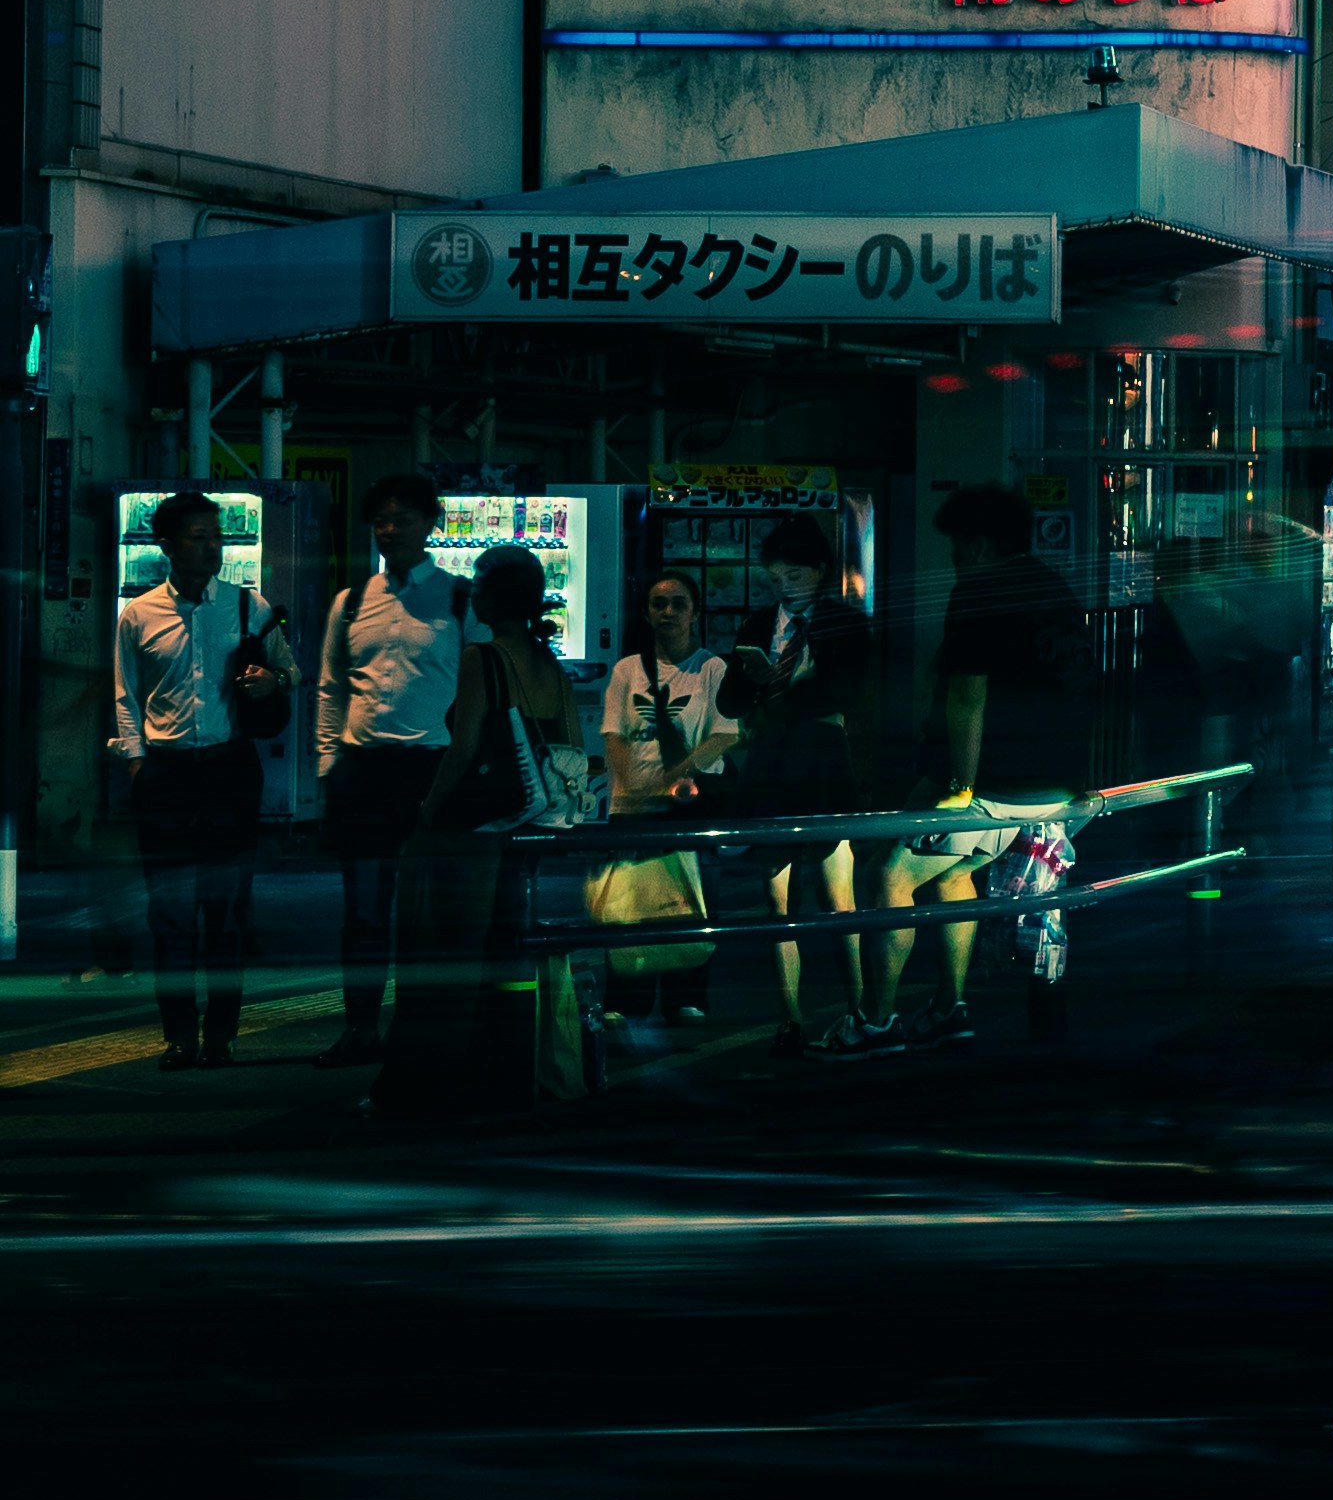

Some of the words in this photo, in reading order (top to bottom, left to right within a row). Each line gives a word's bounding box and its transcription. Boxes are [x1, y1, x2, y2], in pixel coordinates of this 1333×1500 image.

[507, 232, 1045, 304] 相互タクシーのりば
